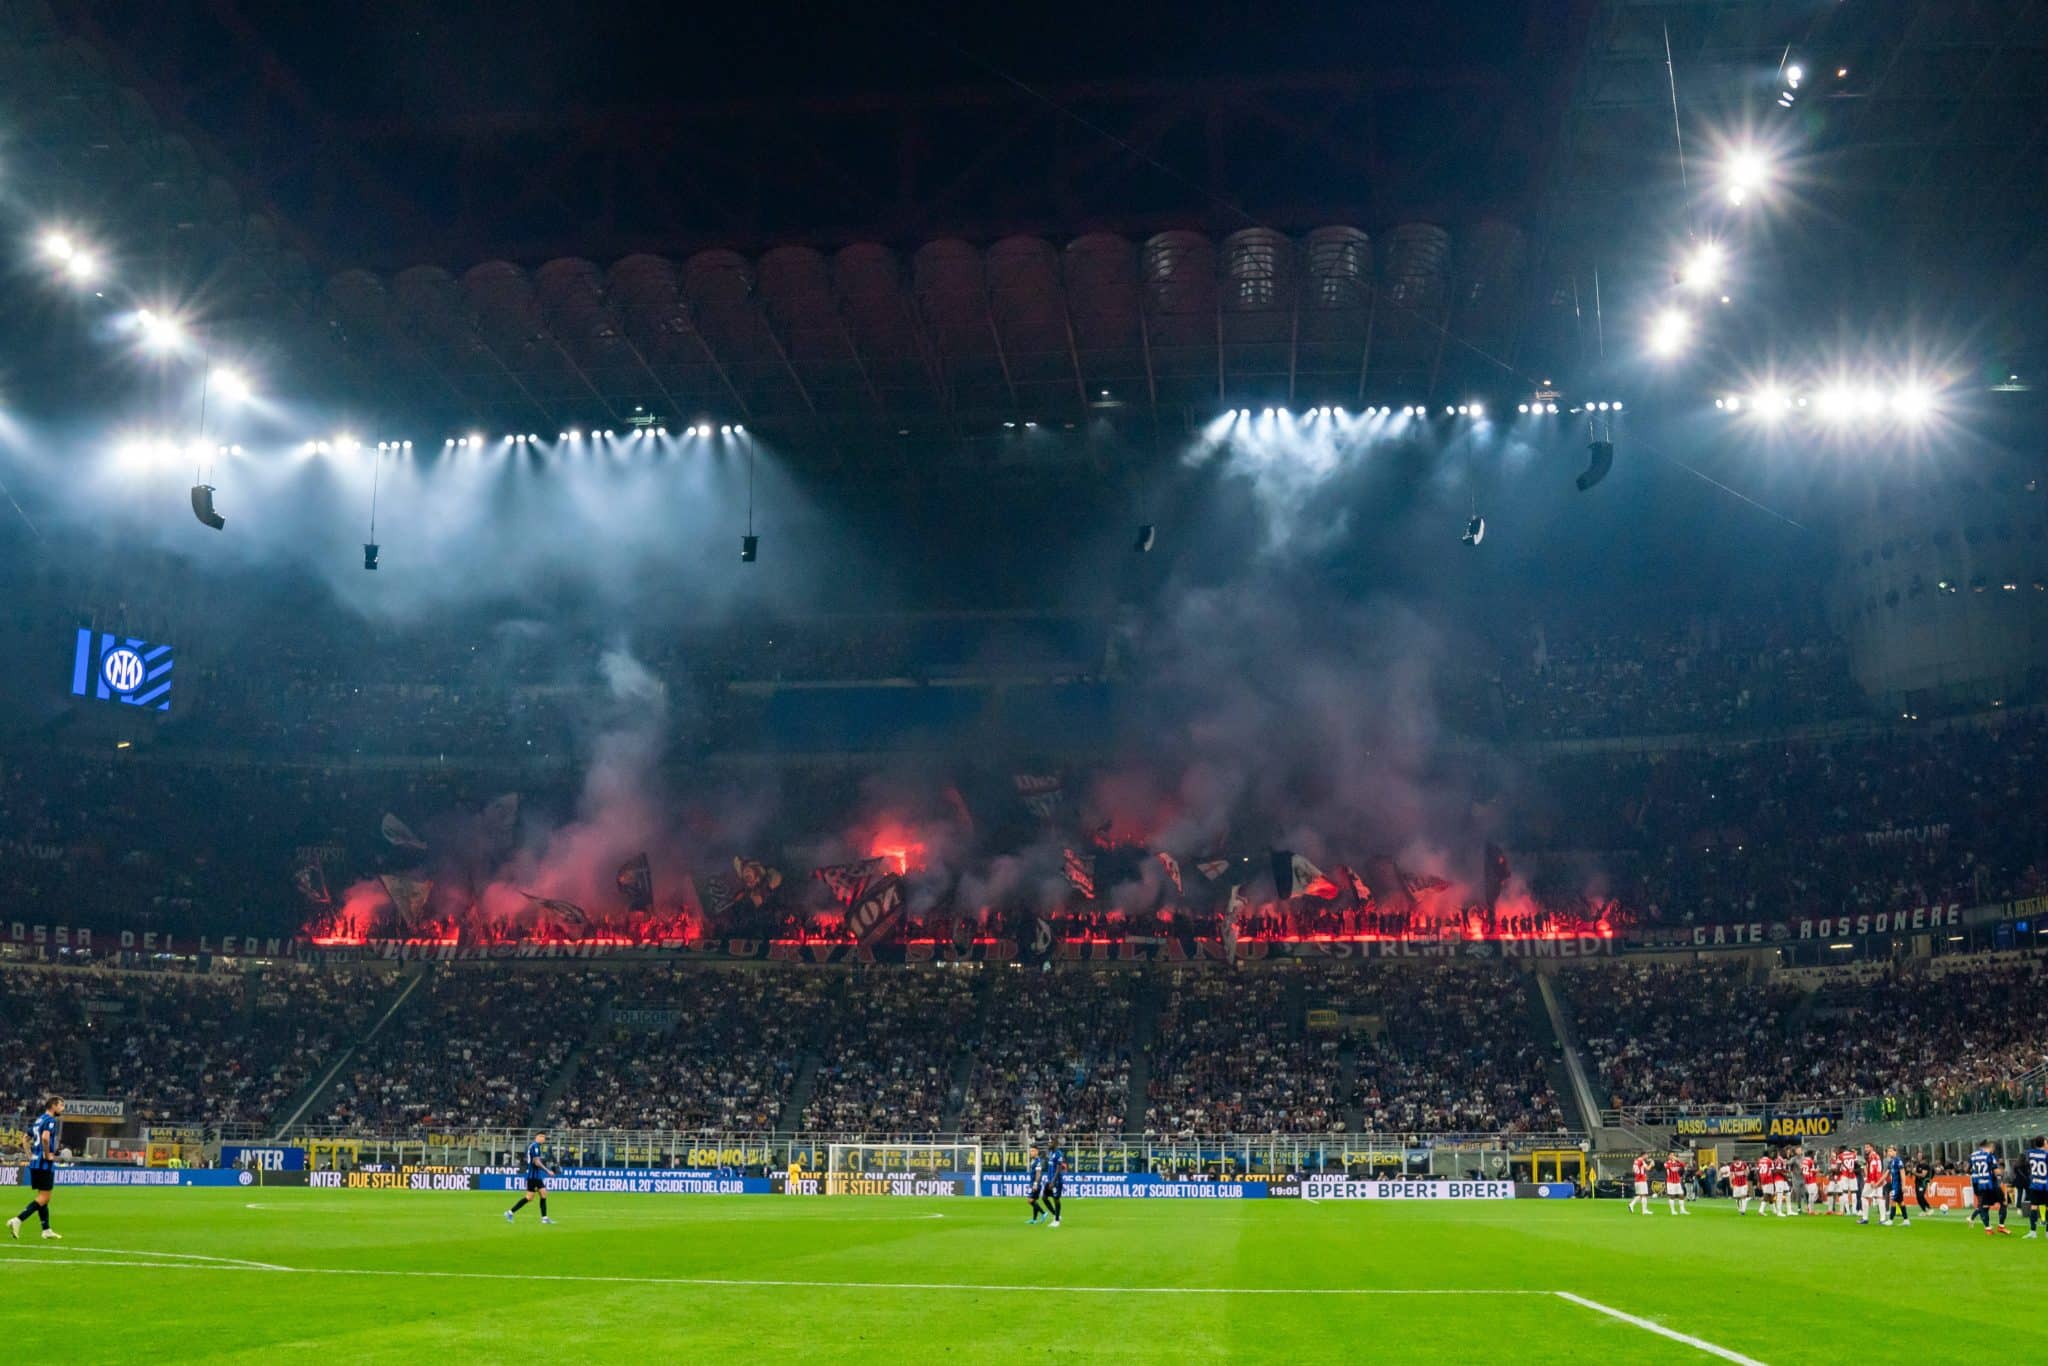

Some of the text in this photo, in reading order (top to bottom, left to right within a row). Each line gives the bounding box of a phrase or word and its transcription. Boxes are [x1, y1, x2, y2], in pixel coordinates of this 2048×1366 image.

[1693, 904, 1960, 944] GATE ROSSONERE
[0, 921, 92, 946] OSSA
[121, 930, 173, 949] DEI
[201, 936, 293, 955] LEONI
[1677, 1117, 1762, 1135] BASSO VICENTINO
[240, 1150, 284, 1170] INTER
[2030, 1159, 2047, 1177] 20
[0, 1167, 19, 1185] UORE
[166, 1171, 179, 1184] CLUB
[309, 1172, 471, 1190] INTER DUE STELLE SUL CUORE
[505, 1177, 513, 1190] IL
[544, 1178, 569, 1191] VENTO
[570, 1178, 588, 1192] CHE
[589, 1178, 628, 1192] CELEBRA
[629, 1179, 637, 1192] IL
[654, 1180, 702, 1193] SCUDETTO
[703, 1180, 719, 1193] DEL
[720, 1180, 744, 1193] CLUB
[850, 1181, 891, 1196] STELLE
[892, 1181, 914, 1196] SUL
[915, 1182, 955, 1196] CUORE
[992, 1184, 1001, 1197] IL
[1080, 1184, 1120, 1198] CELEBRA
[1121, 1184, 1130, 1198] IL
[1149, 1184, 1198, 1198] SCUDETTO
[1199, 1184, 1217, 1198] DEL
[1218, 1184, 1243, 1198] CLUB
[1270, 1187, 1300, 1196] 19:05
